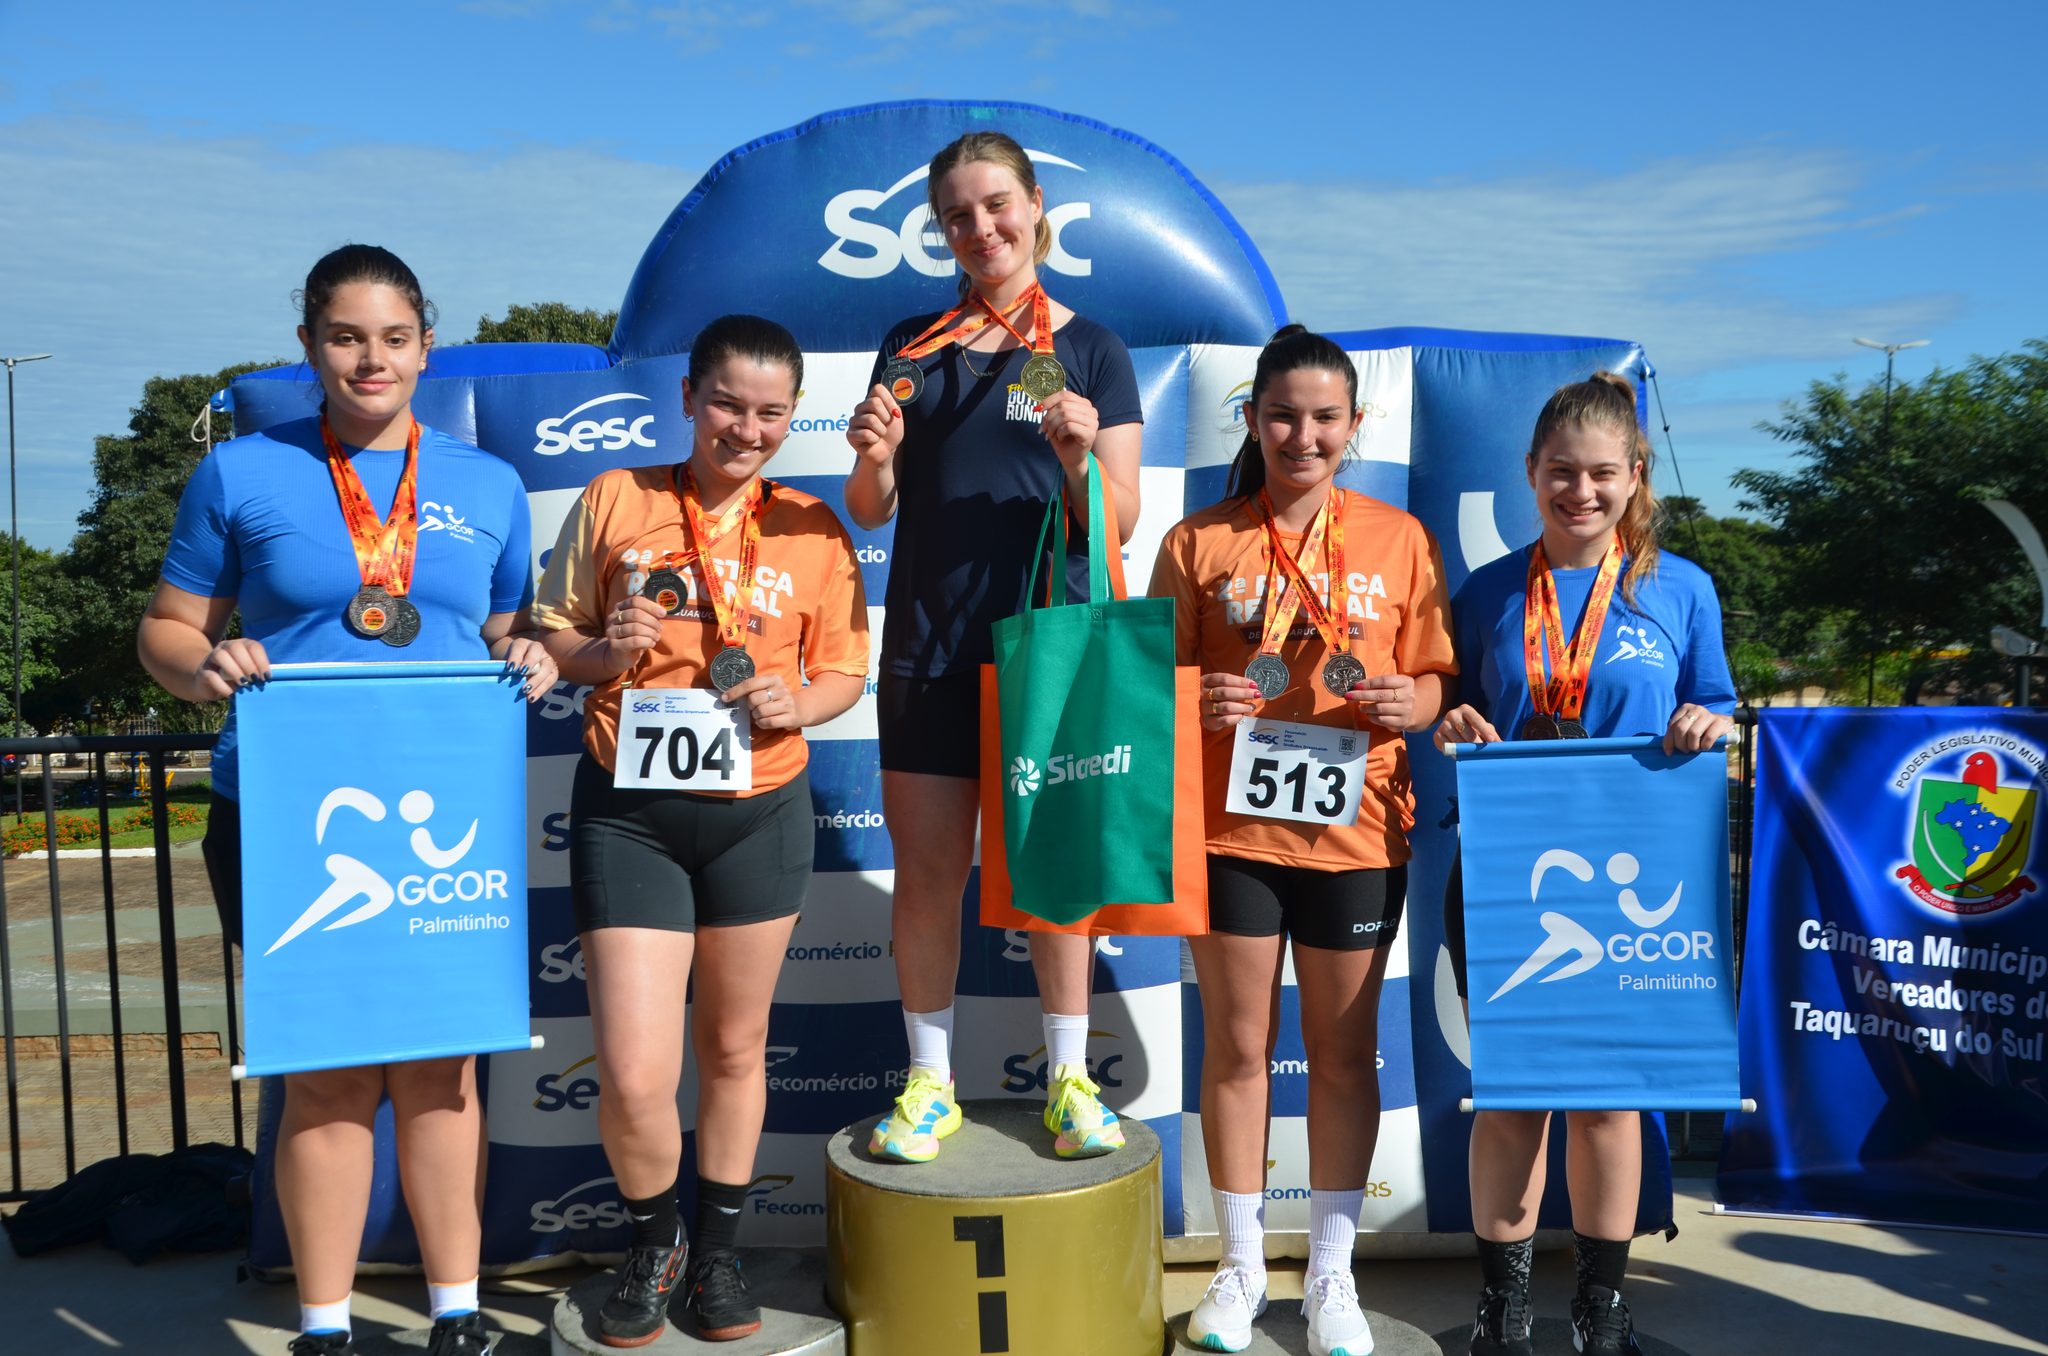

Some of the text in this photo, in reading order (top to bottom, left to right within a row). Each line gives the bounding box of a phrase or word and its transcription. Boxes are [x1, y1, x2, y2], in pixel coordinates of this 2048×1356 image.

[817, 189, 1091, 279] Sec
[445, 522, 474, 536] GCOR
[1638, 648, 1664, 660] GCOR
[632, 702, 660, 713] Sesc
[635, 727, 735, 780] 704
[1248, 731, 1279, 745] Sesc
[1047, 745, 1131, 785] Sicredi
[1895, 751, 1931, 789] PODER
[1930, 735, 2017, 756] LEGISLATIVO
[1246, 757, 1346, 818] 513
[397, 870, 508, 907] GCOR
[409, 914, 511, 935] Palmitinho
[1607, 931, 1715, 963] GCOR
[1797, 919, 2048, 984] Câmara Municip
[1619, 973, 1717, 991] Palmitinho
[1852, 965, 2015, 1015] Vereadores
[1790, 1001, 2044, 1061] Taquaruçu do Sul
[953, 1215, 1009, 1354] 1
